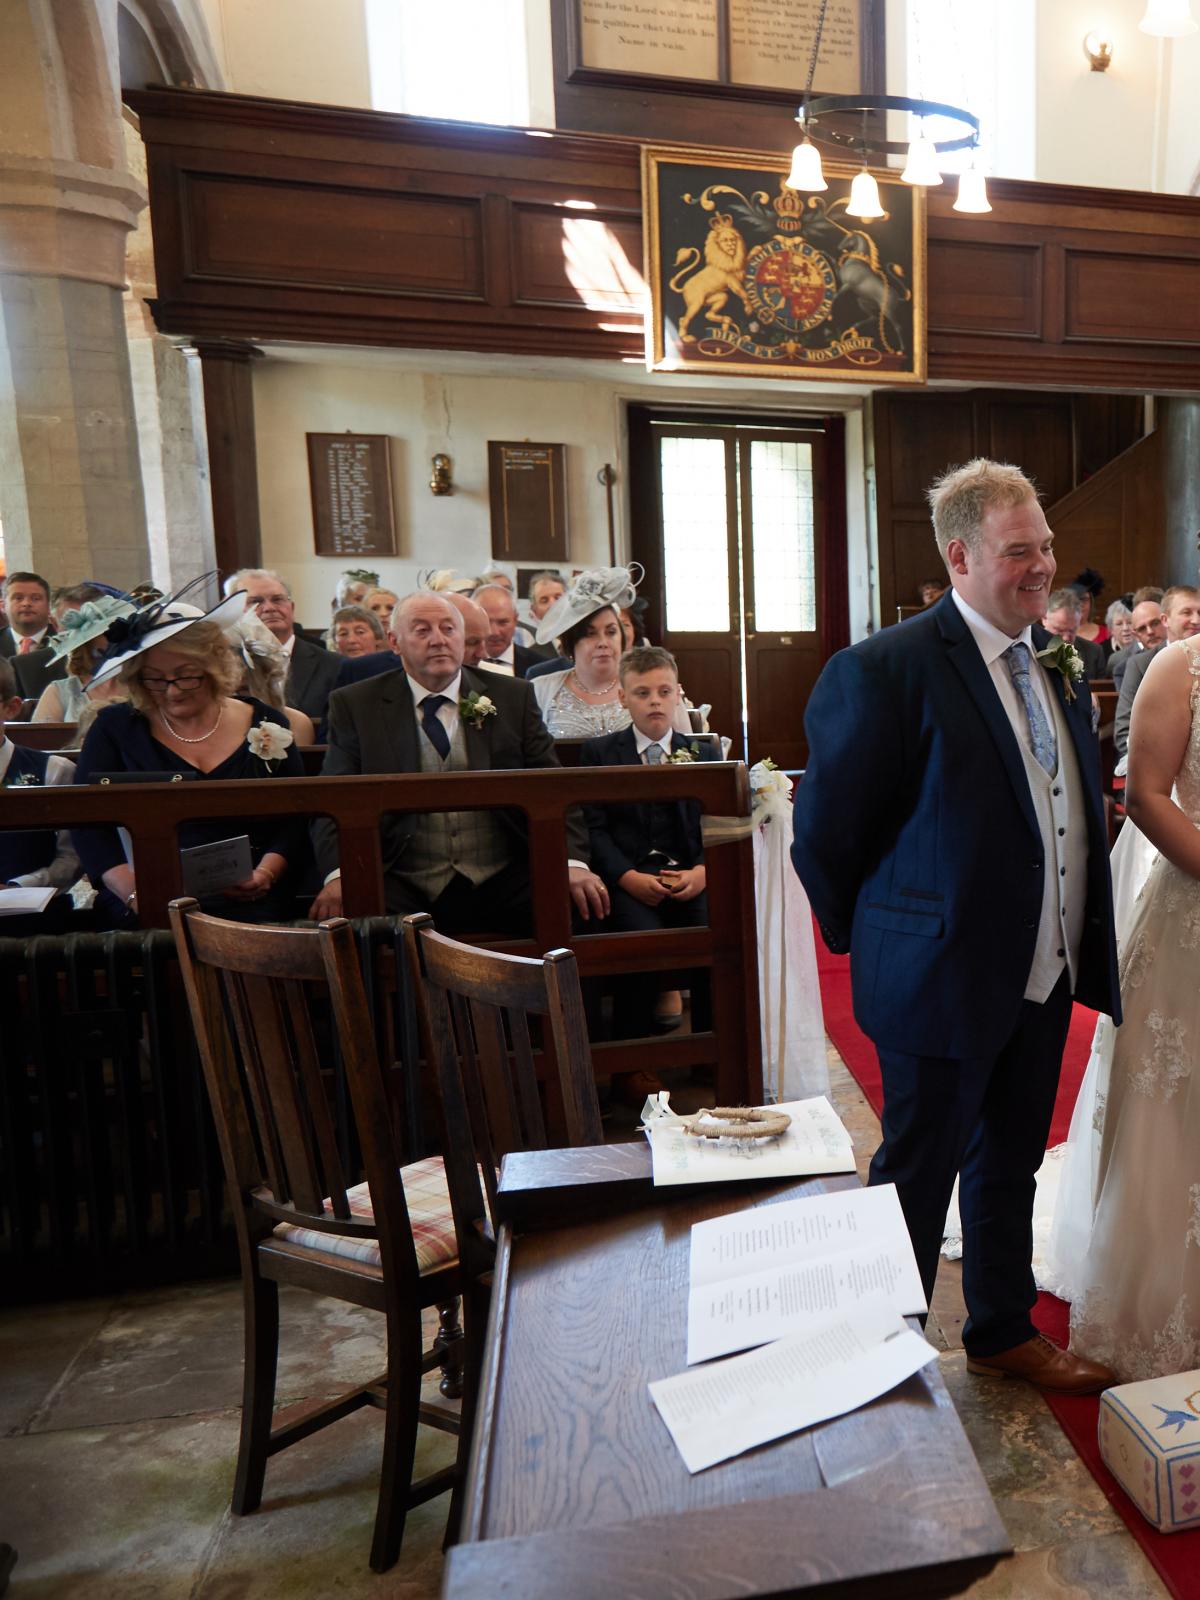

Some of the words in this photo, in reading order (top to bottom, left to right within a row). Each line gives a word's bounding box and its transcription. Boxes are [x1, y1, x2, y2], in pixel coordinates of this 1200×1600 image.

[635, 5, 657, 15] Lord
[643, 24, 663, 32] that
[667, 26, 697, 36] taketh
[618, 35, 645, 46] Name
[711, 327, 742, 347] DIEU
[755, 344, 774, 358] ET
[806, 349, 832, 361] MON
[837, 336, 875, 354] DROIT
